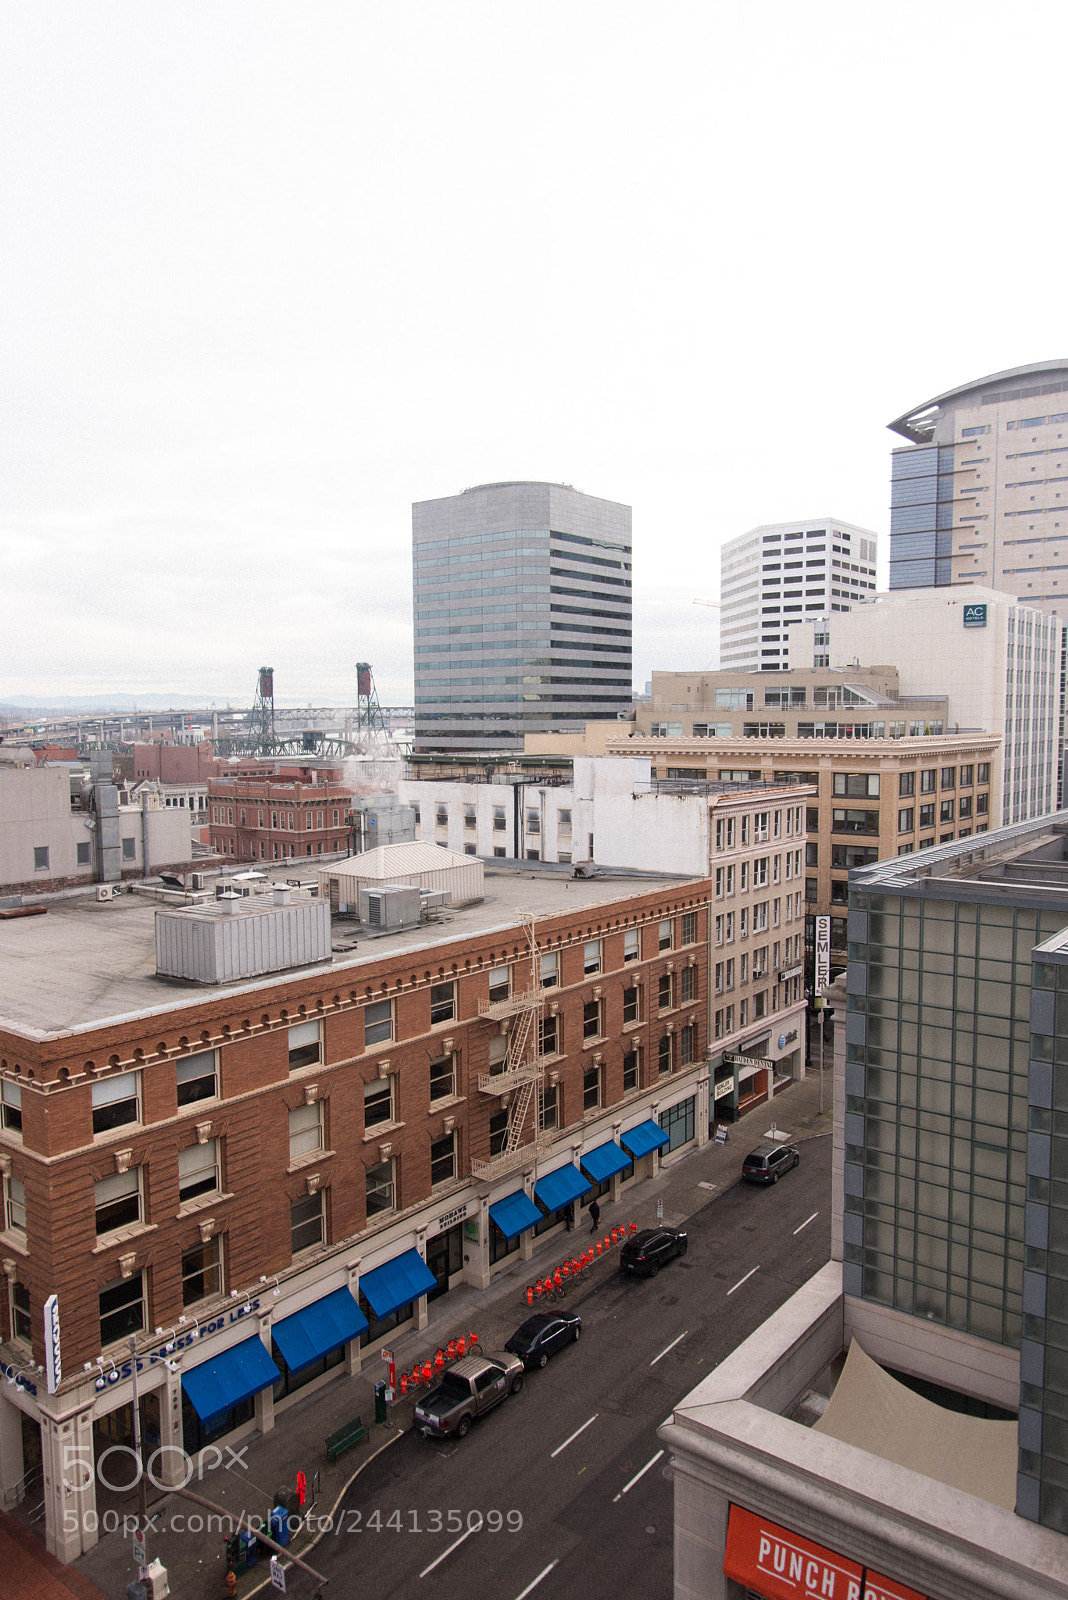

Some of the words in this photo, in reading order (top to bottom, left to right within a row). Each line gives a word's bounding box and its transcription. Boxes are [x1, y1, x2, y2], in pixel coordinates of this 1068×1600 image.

[966, 607, 984, 616] AC
[817, 918, 828, 988] SEMLER
[439, 1204, 467, 1224] MOHAWK
[440, 1212, 467, 1229] BUILDING
[95, 1359, 144, 1392] ROSS
[150, 1335, 194, 1364] DRESS
[200, 1316, 225, 1338] FOR
[230, 1298, 261, 1323] LESS
[758, 1536, 836, 1598] PUNCH
